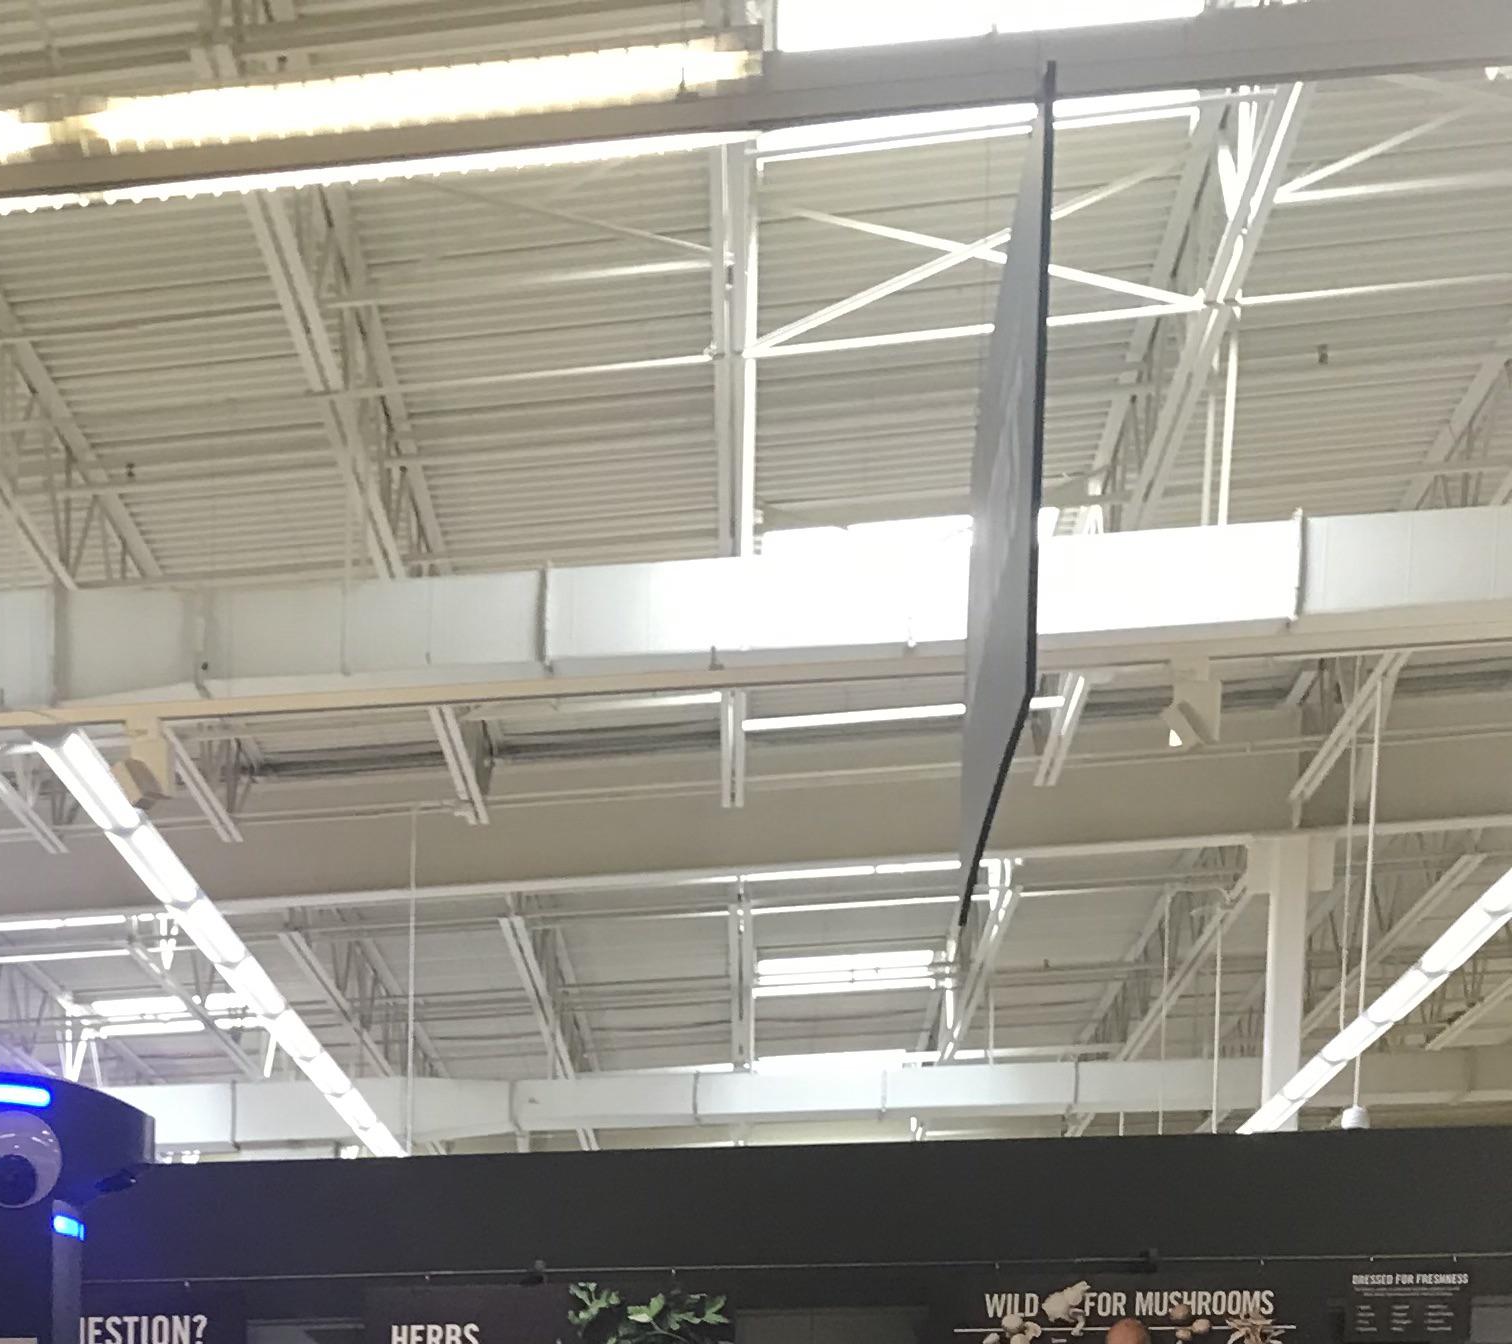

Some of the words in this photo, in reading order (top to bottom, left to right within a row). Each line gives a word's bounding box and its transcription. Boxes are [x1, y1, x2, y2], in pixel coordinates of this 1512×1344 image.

[1395, 1273, 1414, 1284] FOR
[1416, 1273, 1469, 1284] FRESHNESS
[985, 1293, 1039, 1318] WILD
[1084, 1292, 1126, 1317] FOR
[1135, 1290, 1275, 1317] MUSHROOMS
